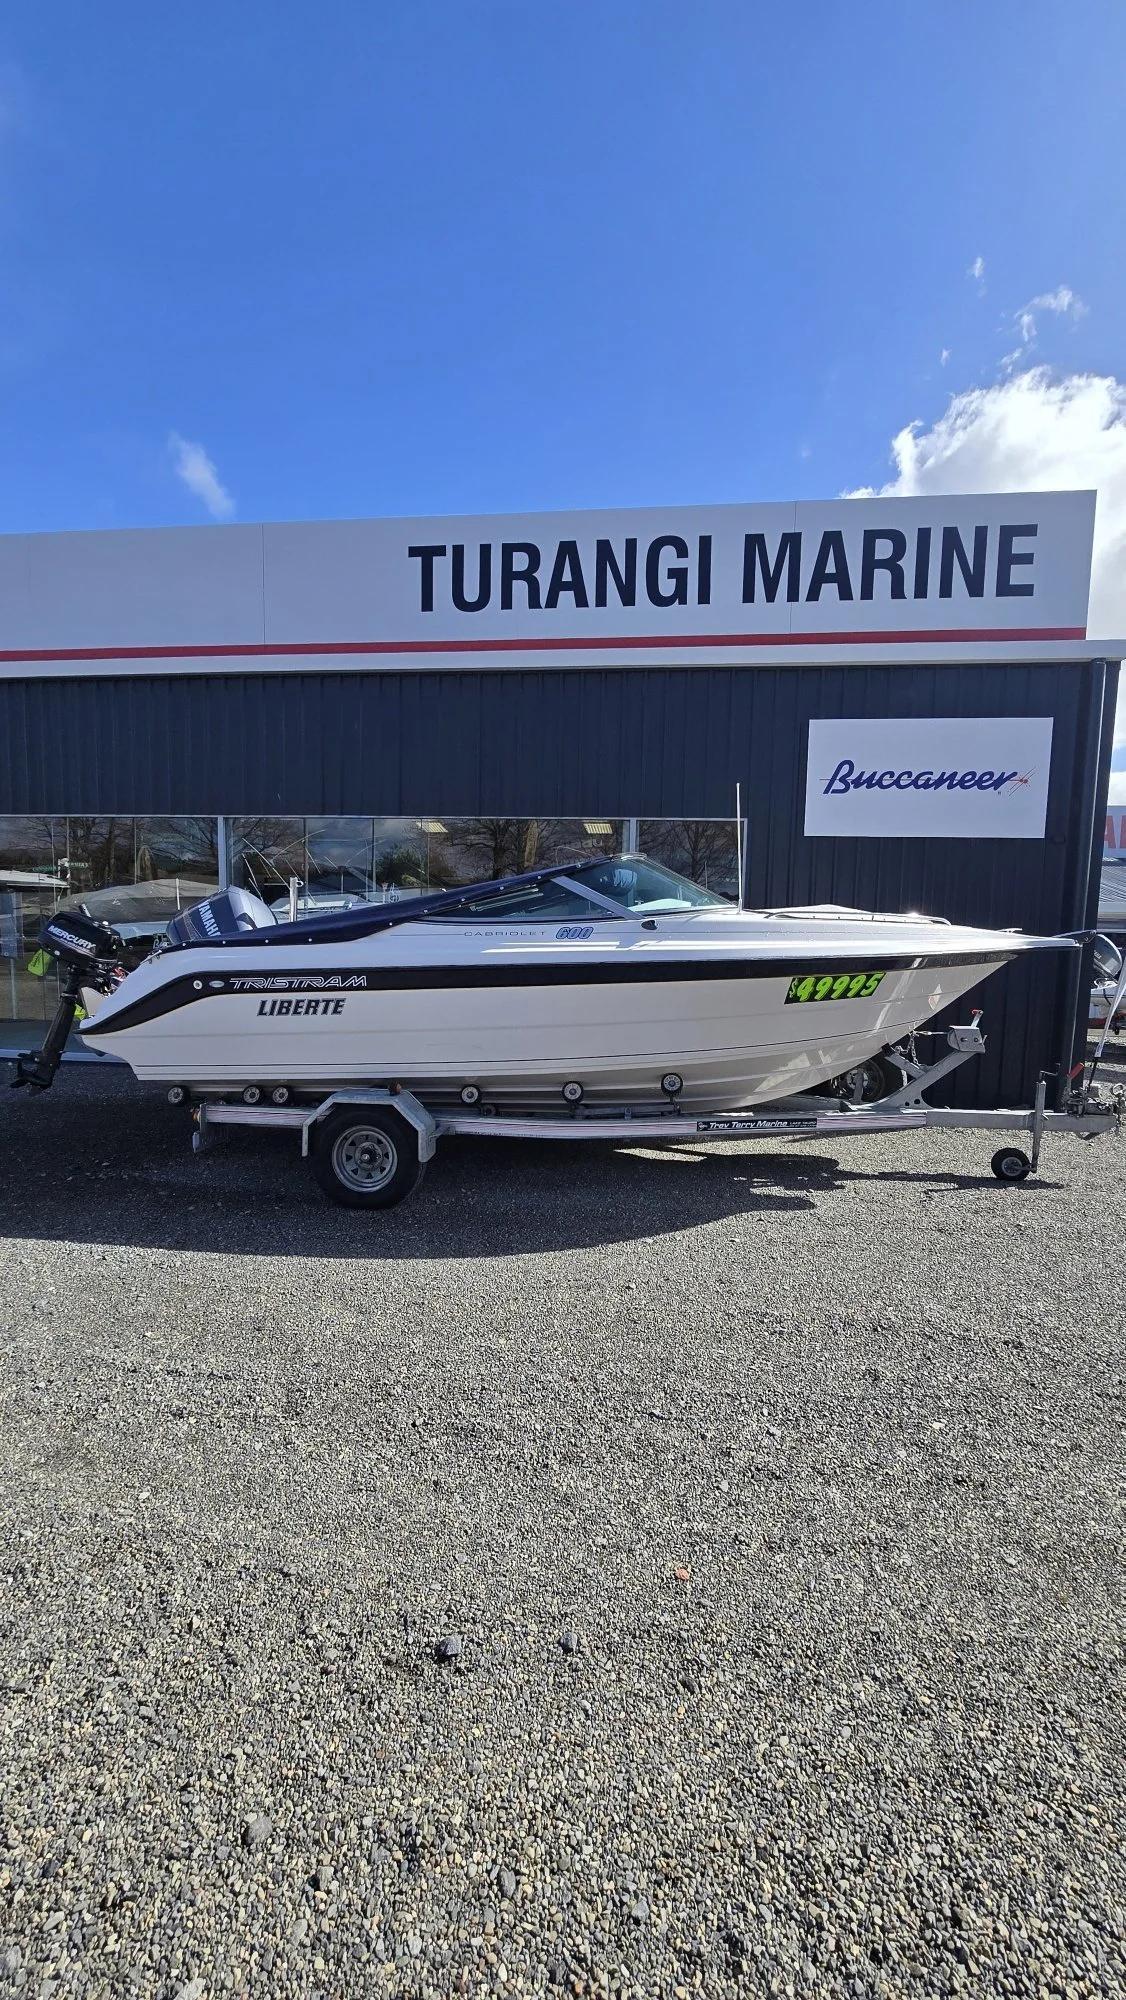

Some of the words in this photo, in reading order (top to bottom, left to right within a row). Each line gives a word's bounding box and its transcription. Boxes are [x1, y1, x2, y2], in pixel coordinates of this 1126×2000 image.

[407, 534, 713, 613] TURANGI
[741, 523, 1039, 604] MARINE
[822, 759, 1019, 795] Buccaneer
[47, 924, 97, 951] MERCURY
[555, 926, 595, 940] 600
[229, 975, 368, 990] TRISTRAM
[788, 972, 885, 1002] $49995
[256, 998, 347, 1017] LIBERTE
[756, 1120, 788, 1128] Marine
